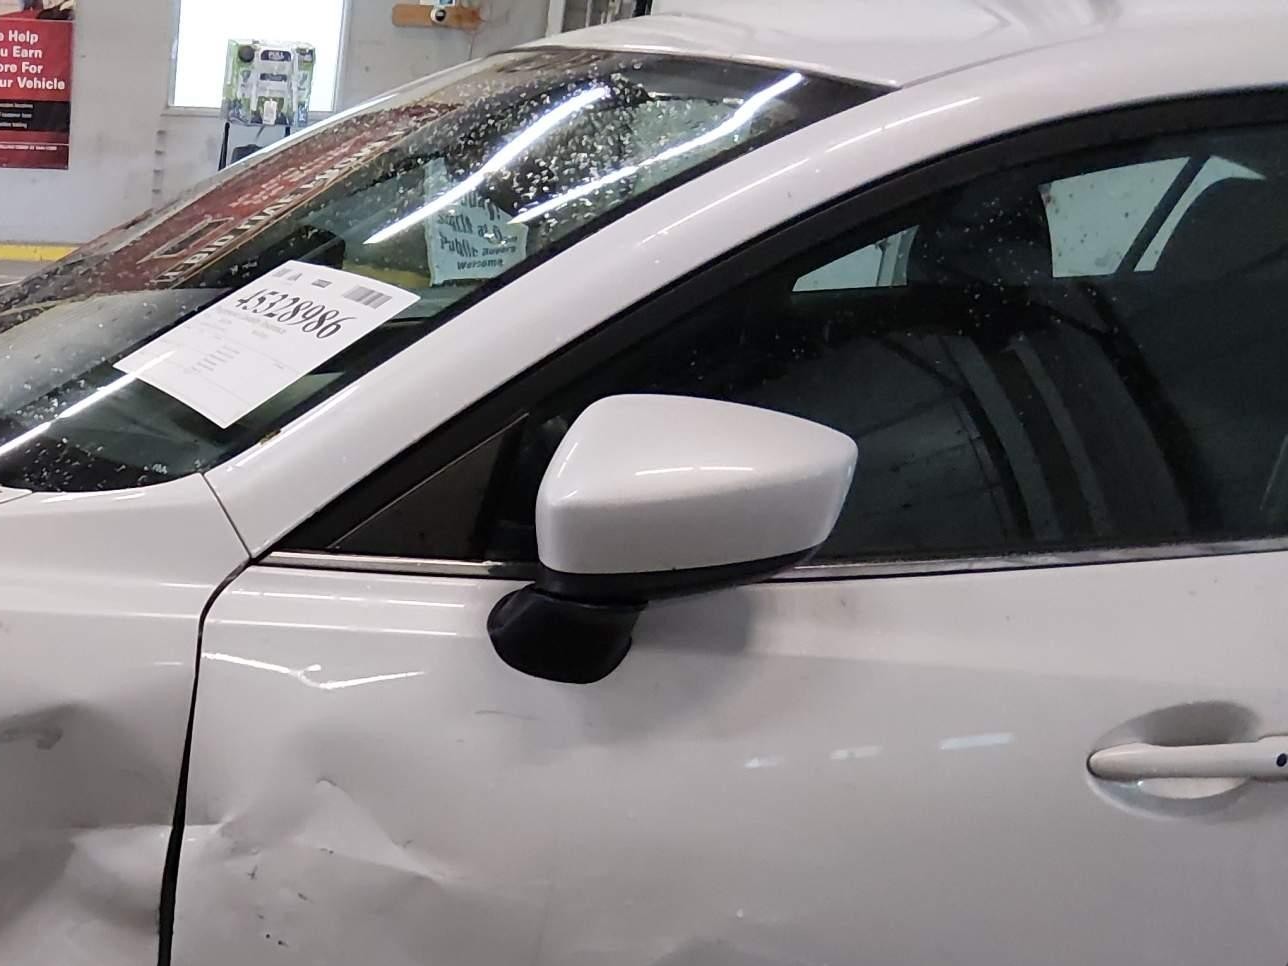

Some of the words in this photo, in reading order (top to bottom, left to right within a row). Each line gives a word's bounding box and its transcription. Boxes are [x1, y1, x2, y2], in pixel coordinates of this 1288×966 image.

[8, 30, 39, 45] Help
[13, 46, 43, 59] Earn
[21, 62, 44, 74] For
[16, 76, 66, 90] Vehicle
[439, 231, 479, 258] Public
[236, 288, 357, 340] 45328986
